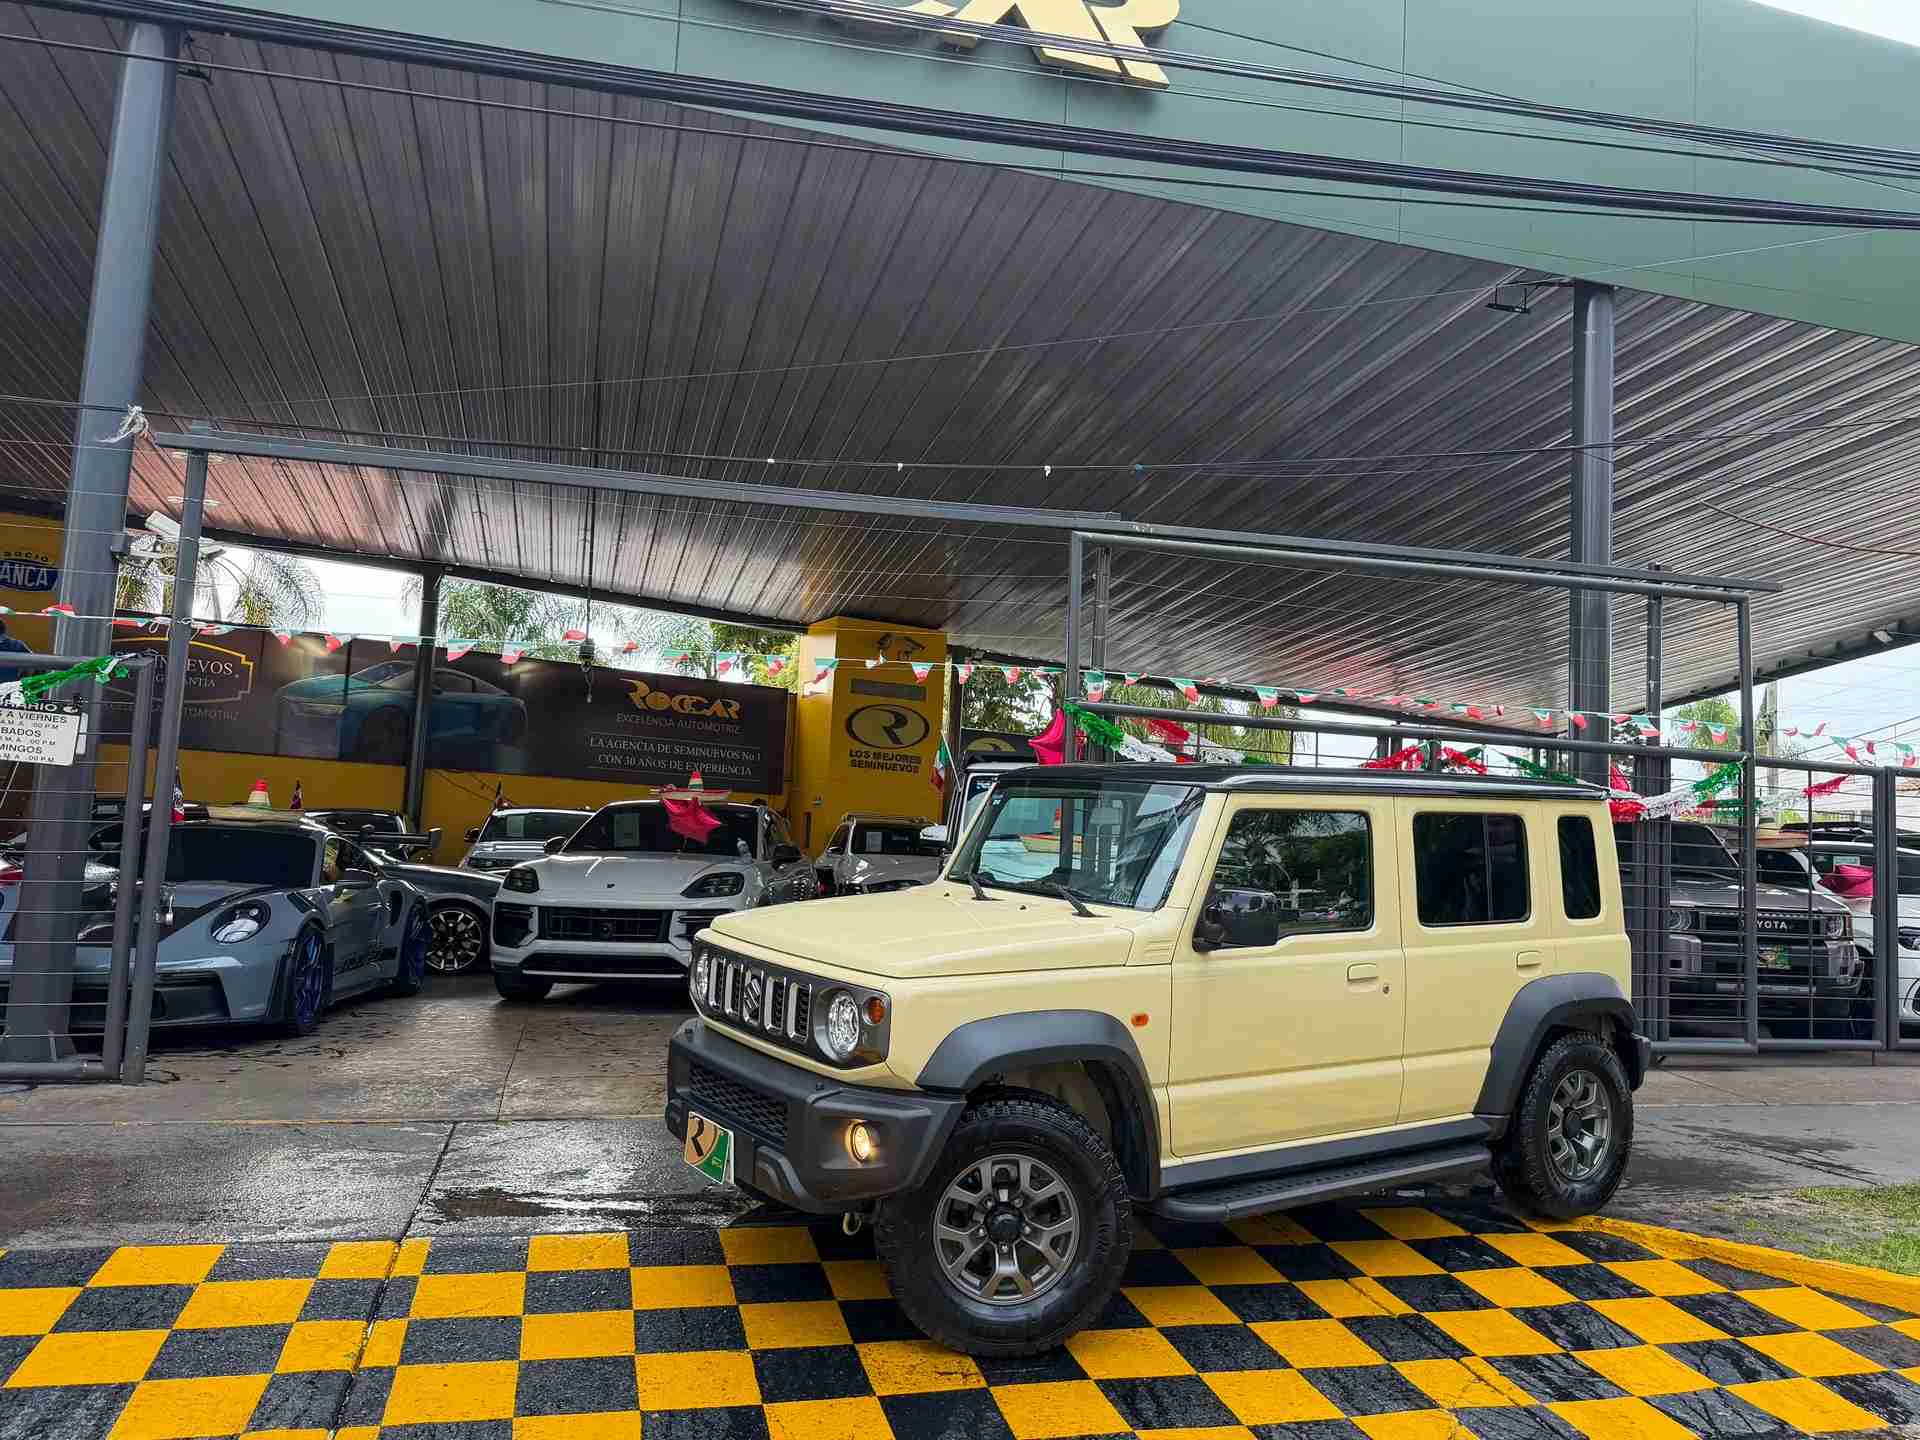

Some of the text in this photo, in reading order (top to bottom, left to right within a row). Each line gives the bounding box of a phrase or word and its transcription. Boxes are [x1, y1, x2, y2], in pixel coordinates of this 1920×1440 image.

[18, 711, 68, 724] VIERNES
[850, 750, 921, 764] LOS MEJORES
[850, 759, 919, 774] SEMINUEVOS
